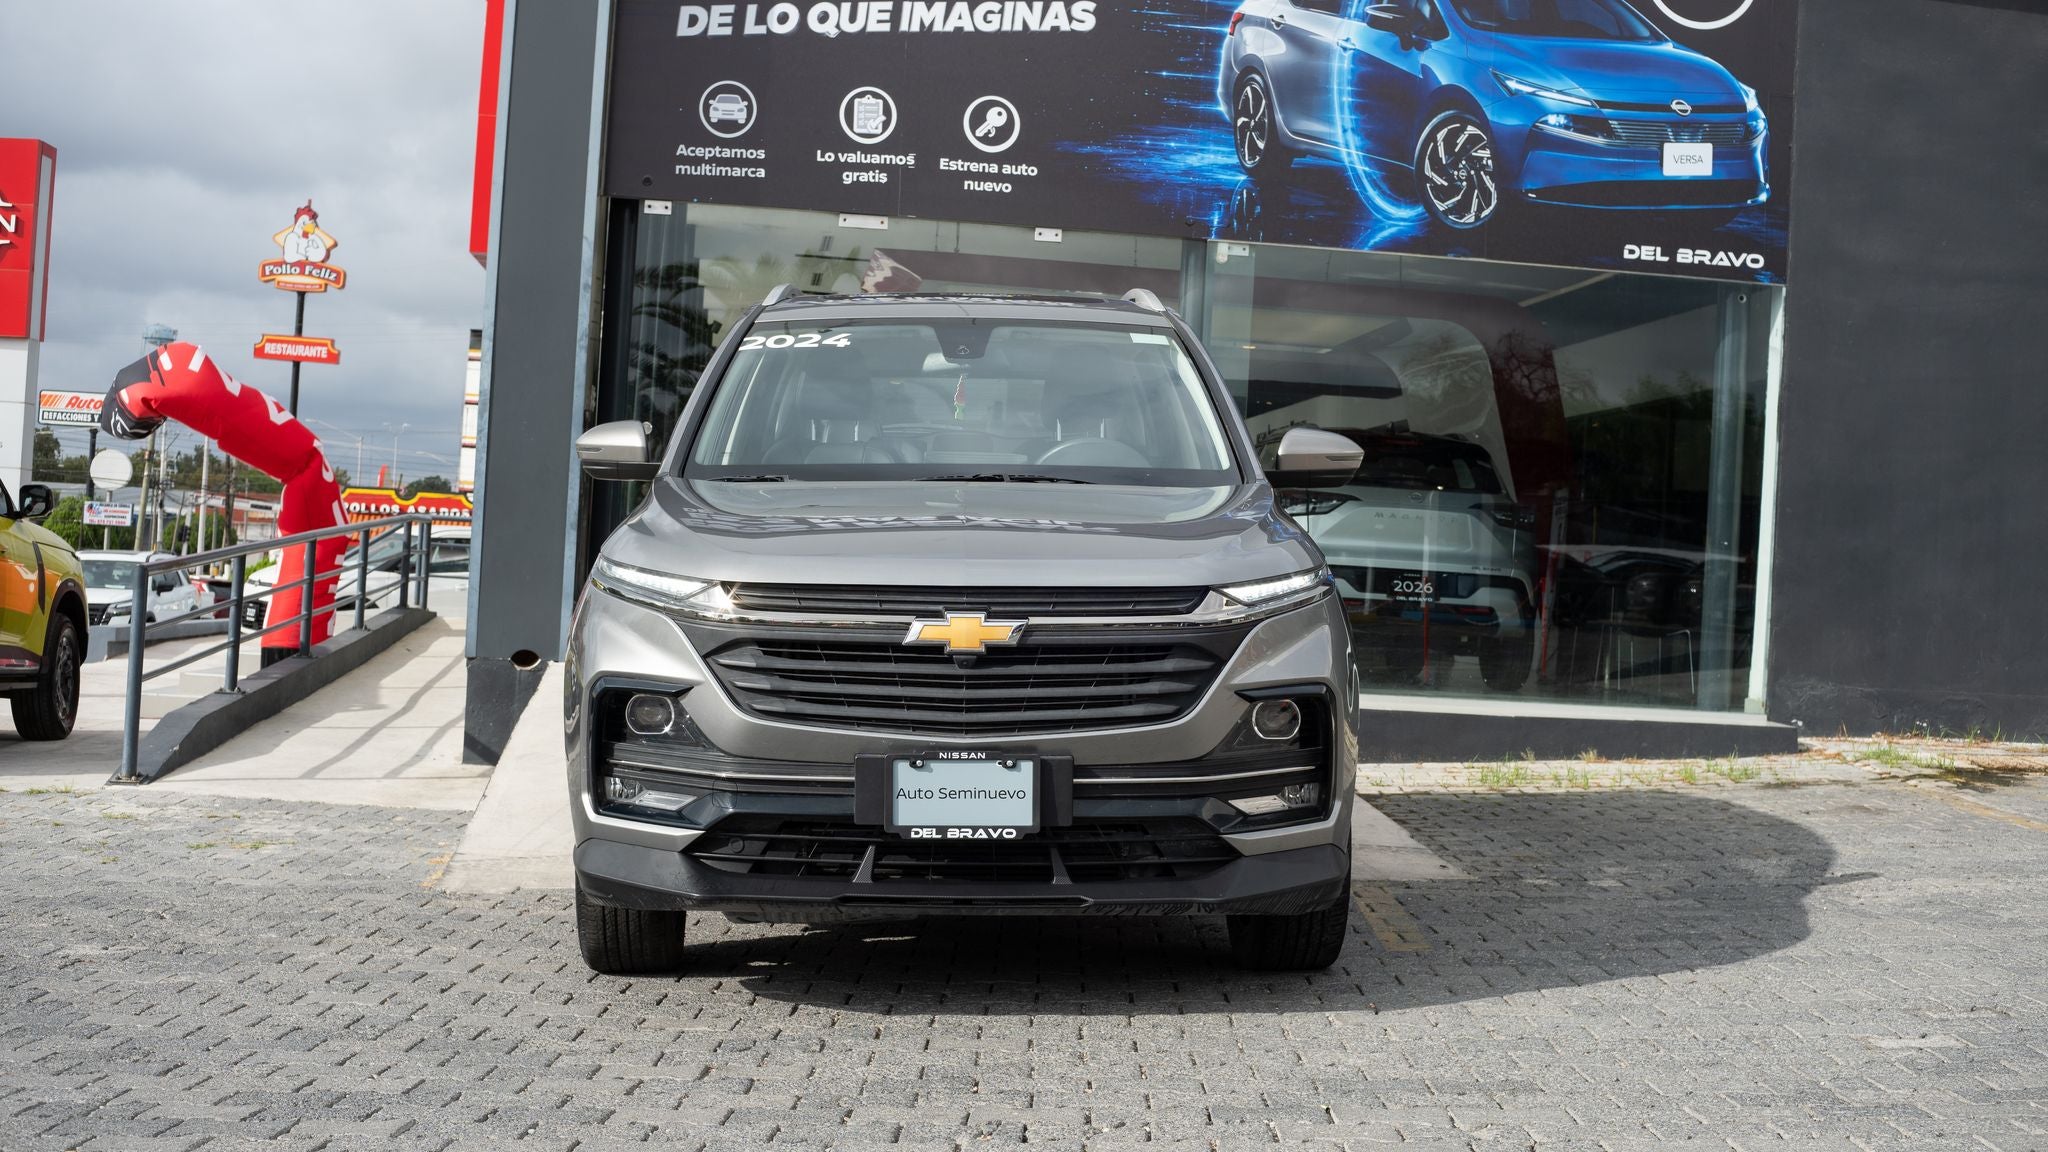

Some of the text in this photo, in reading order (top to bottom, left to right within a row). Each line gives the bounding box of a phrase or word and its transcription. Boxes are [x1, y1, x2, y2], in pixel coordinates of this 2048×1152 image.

[676, 0, 1098, 38] DE LO QUE IMAGINAS
[676, 144, 766, 160] Aceptamos
[816, 150, 916, 166] Lo valuamos
[1673, 154, 1704, 165] VERSA
[675, 163, 766, 178] multimarca
[939, 158, 1038, 176] Estrena auto
[842, 169, 888, 184] gratis
[963, 179, 1012, 193] nuevo
[1623, 244, 1765, 269] DEL BRAVO
[264, 264, 338, 281] Pollo Feliz
[738, 333, 852, 351] 2024
[264, 342, 328, 358] RESTAURANTE
[65, 395, 104, 410] Auto
[43, 411, 99, 422] REFACCIONES Y
[1393, 580, 1433, 594] 2026
[896, 787, 1026, 800] Auto Seminuevo
[911, 828, 1017, 839] DEL BRAVO
